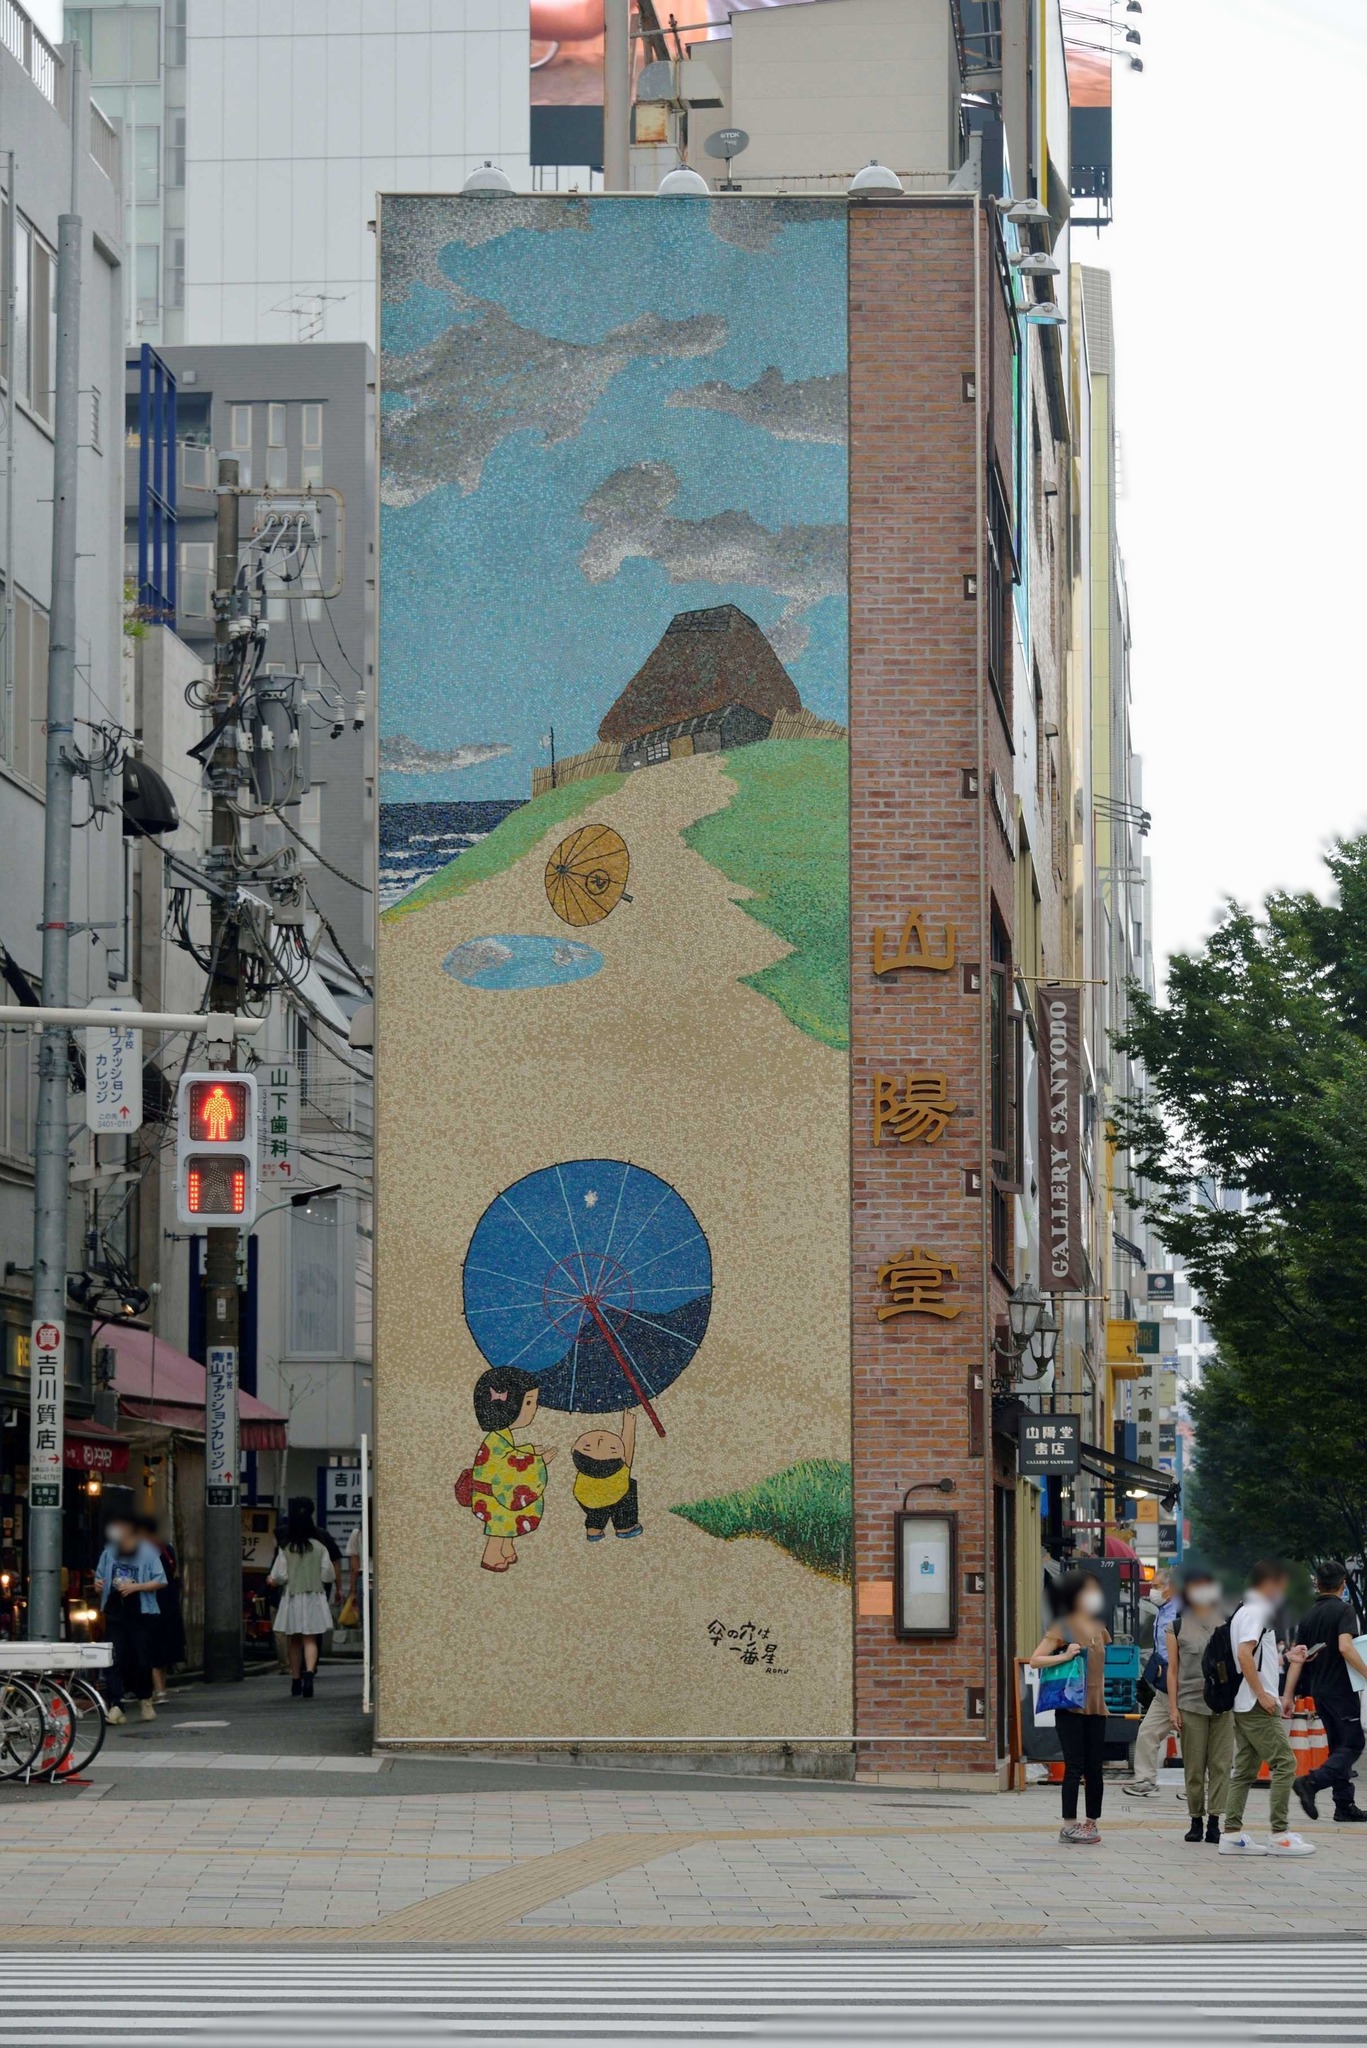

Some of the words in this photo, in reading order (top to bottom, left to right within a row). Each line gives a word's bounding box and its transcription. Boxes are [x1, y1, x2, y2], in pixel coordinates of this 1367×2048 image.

[96, 1054, 108, 1103] カレッジ
[1050, 1000, 1068, 1135] SANYODO
[271, 1068, 288, 1158] 山下歯科
[874, 907, 962, 1321] 山陽堂
[1051, 1144, 1070, 1279] GALLERY
[211, 1352, 226, 1470] 青山ファッションカレッジ
[1026, 1426, 1074, 1439] 山陽堂
[1035, 1442, 1065, 1455] 書店
[729, 1641, 777, 1665] 一番星
